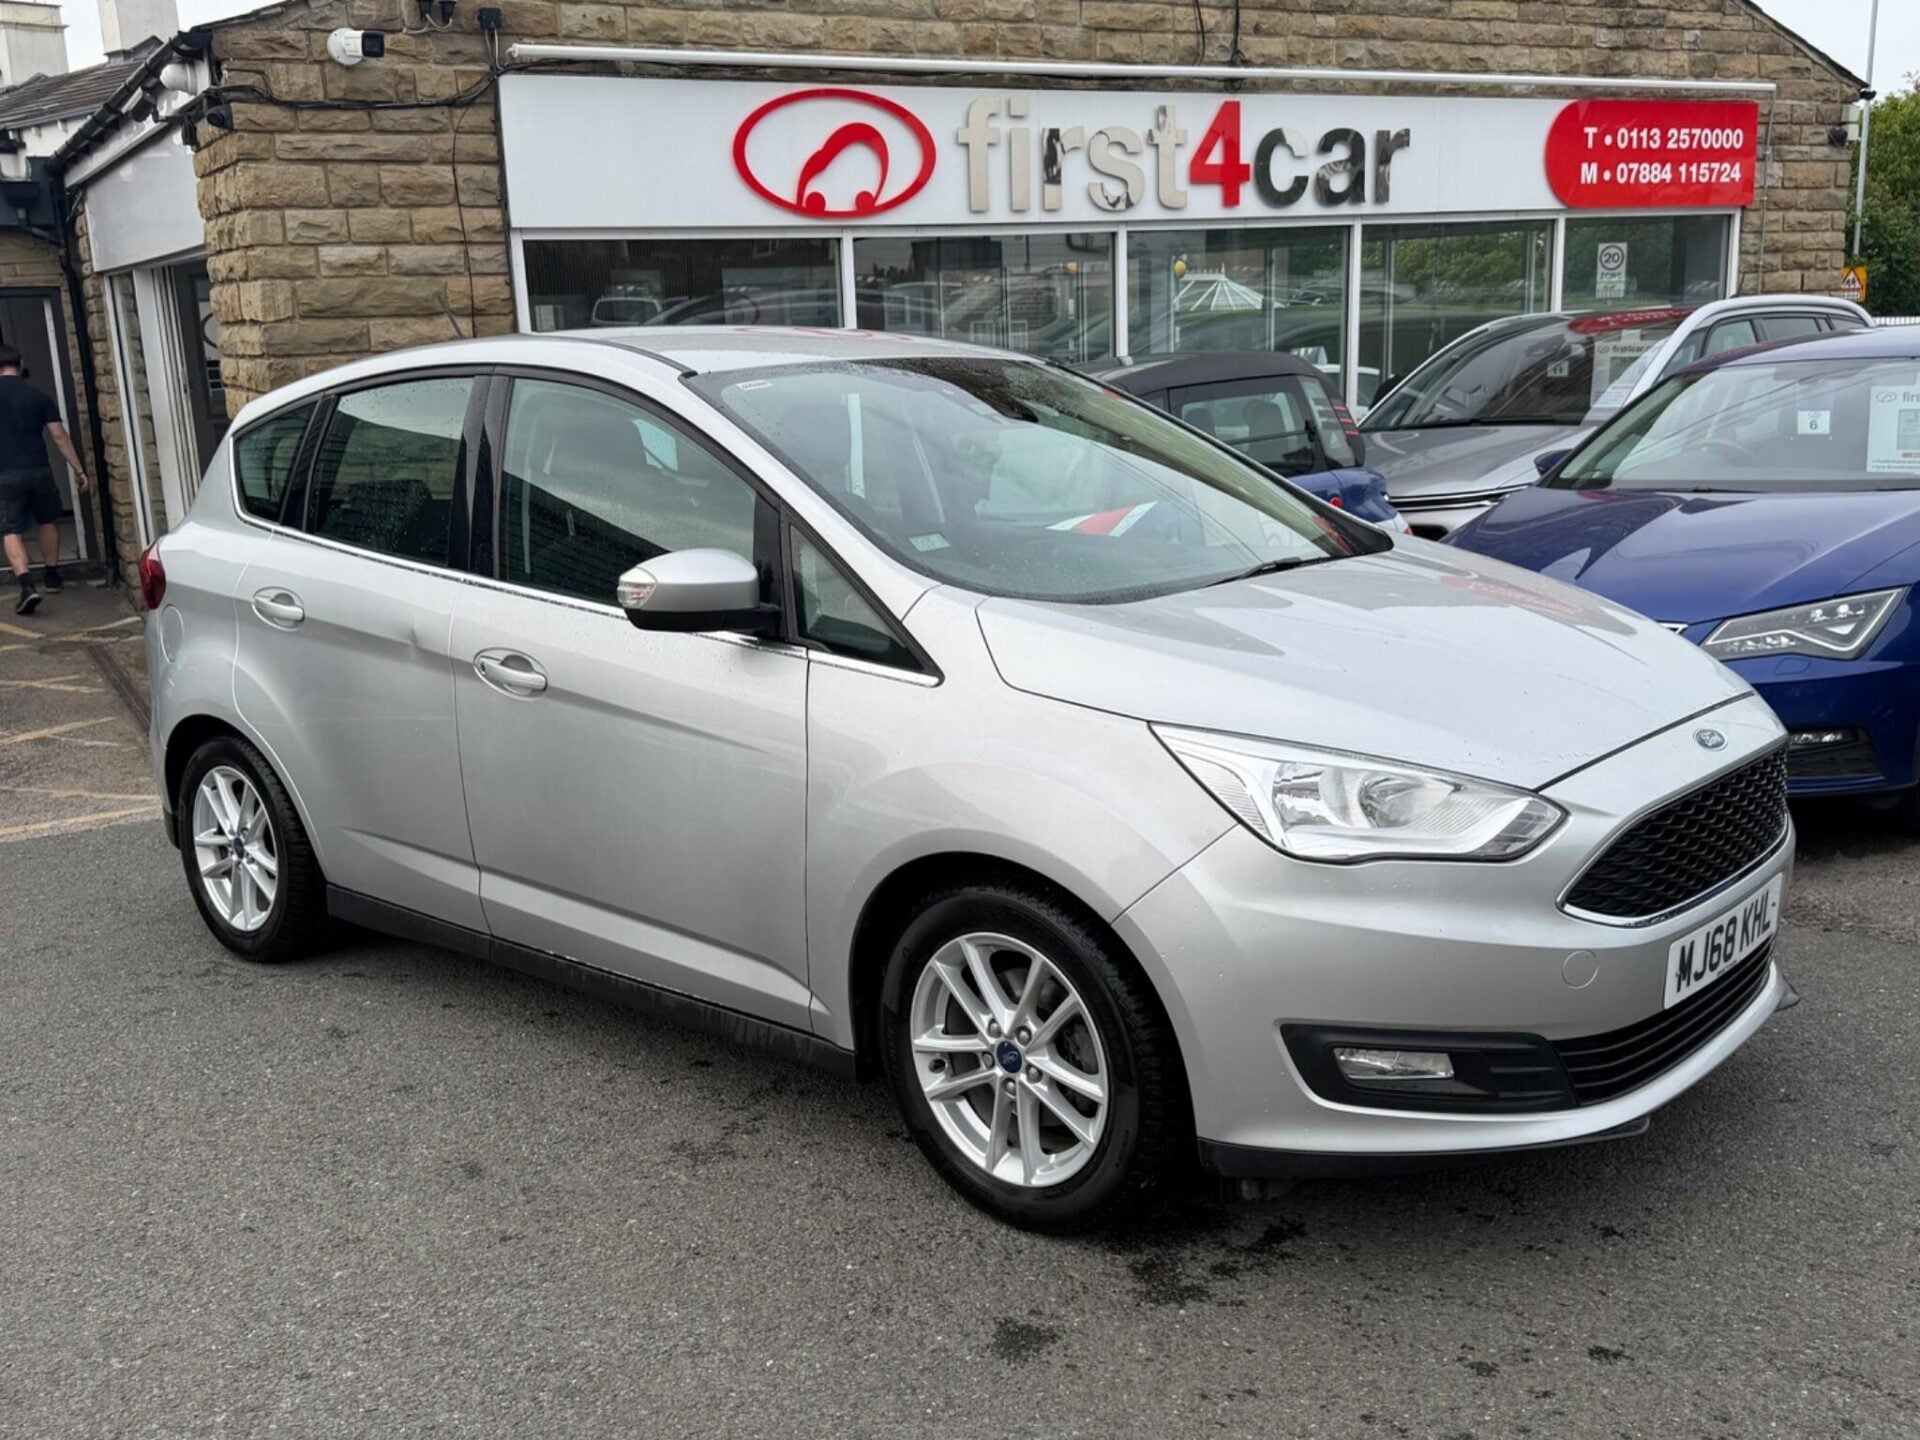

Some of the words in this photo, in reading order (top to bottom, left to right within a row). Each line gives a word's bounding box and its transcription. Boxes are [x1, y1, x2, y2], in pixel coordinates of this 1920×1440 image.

[1583, 127, 1598, 149] T
[1617, 127, 1661, 149] 0113
[1667, 128, 1744, 149] 2570000
[956, 96, 1411, 212] first4car
[1580, 162, 1598, 185] M
[1616, 162, 1672, 184] 07884
[1679, 162, 1741, 183] 115724
[1603, 252, 1620, 263] 20
[1809, 420, 1818, 431] 6
[1676, 915, 1737, 993] MJ68
[1739, 890, 1770, 953] KHL
